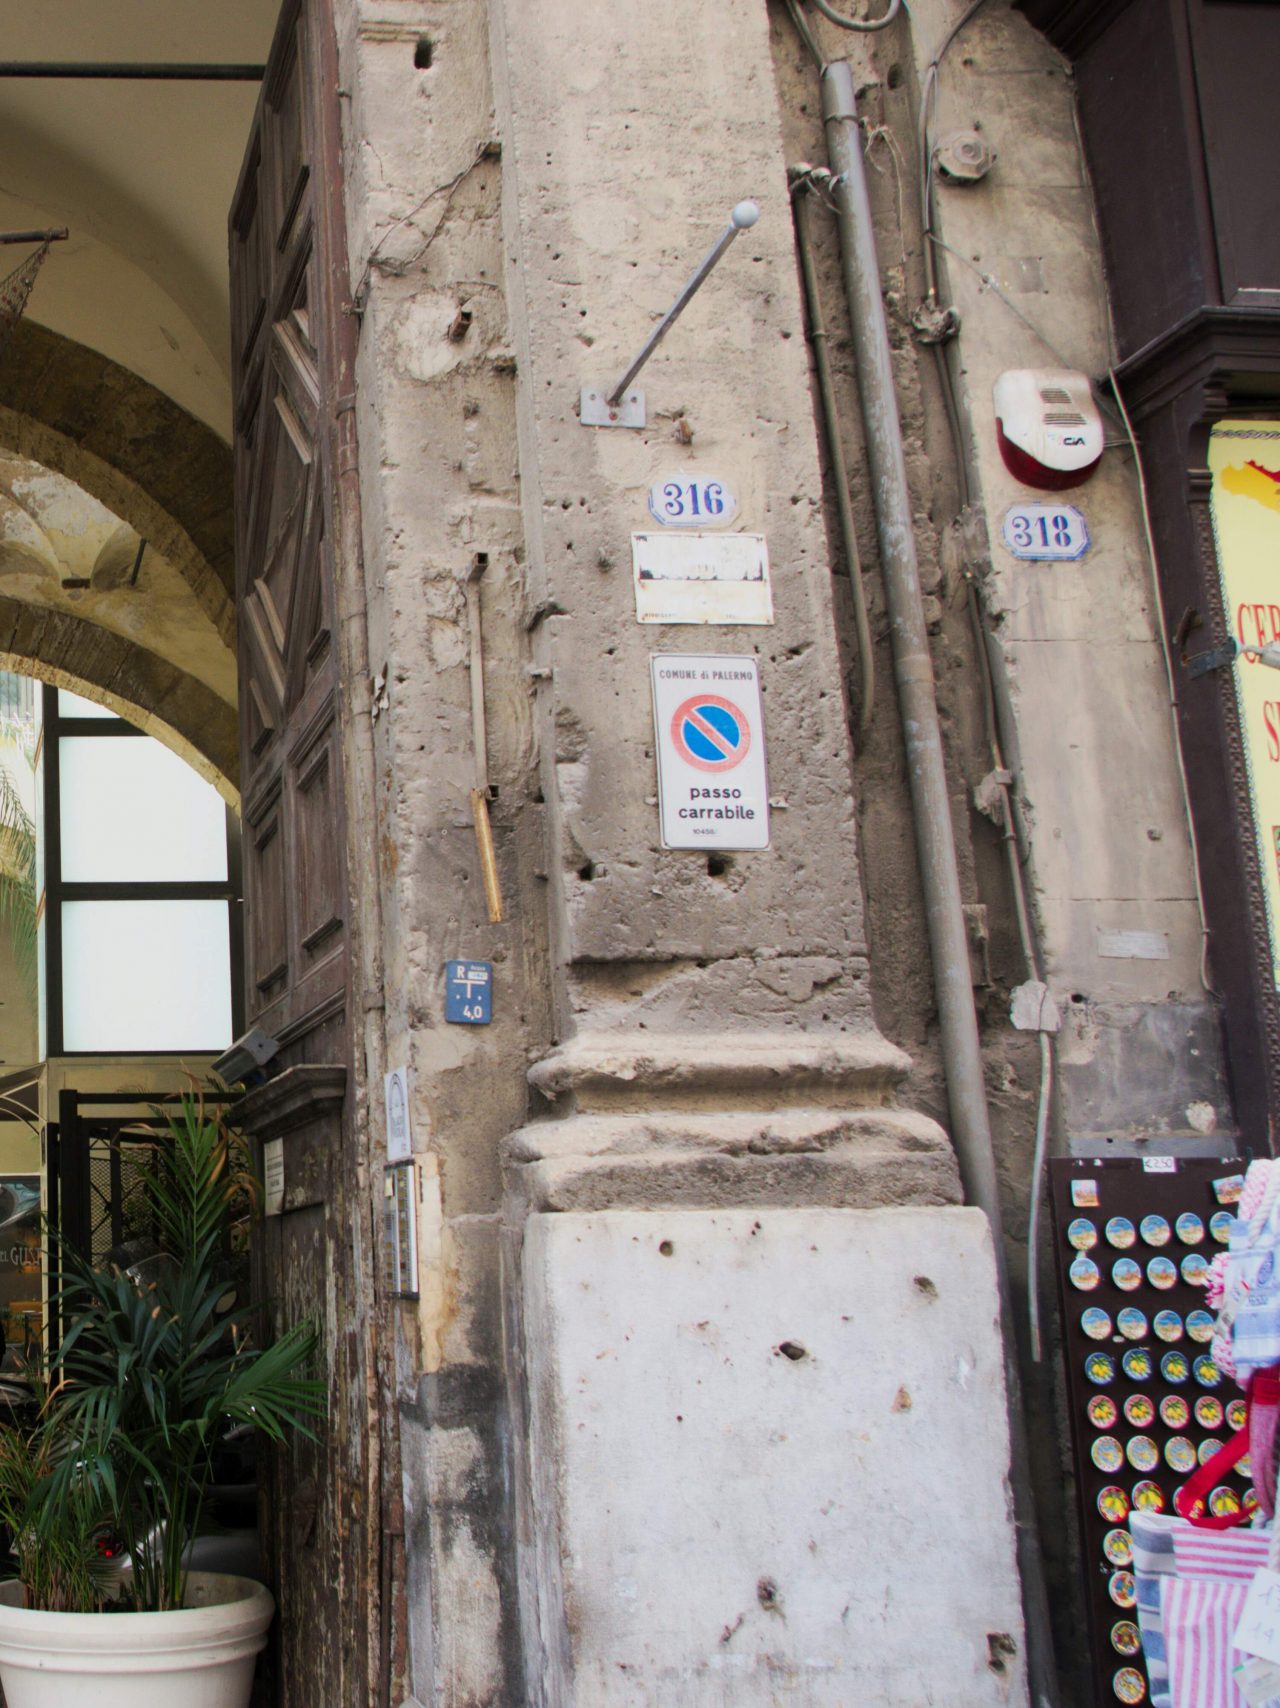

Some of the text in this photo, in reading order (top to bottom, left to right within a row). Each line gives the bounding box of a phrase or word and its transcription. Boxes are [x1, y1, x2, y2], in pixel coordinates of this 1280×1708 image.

[663, 483, 724, 516] 316
[1012, 515, 1071, 547] 318
[659, 670, 753, 681] COMUNE di PALERMO
[690, 787, 741, 801] passo
[678, 806, 755, 820] carrabile
[457, 965, 465, 979] R
[463, 1005, 483, 1021] 4,0
